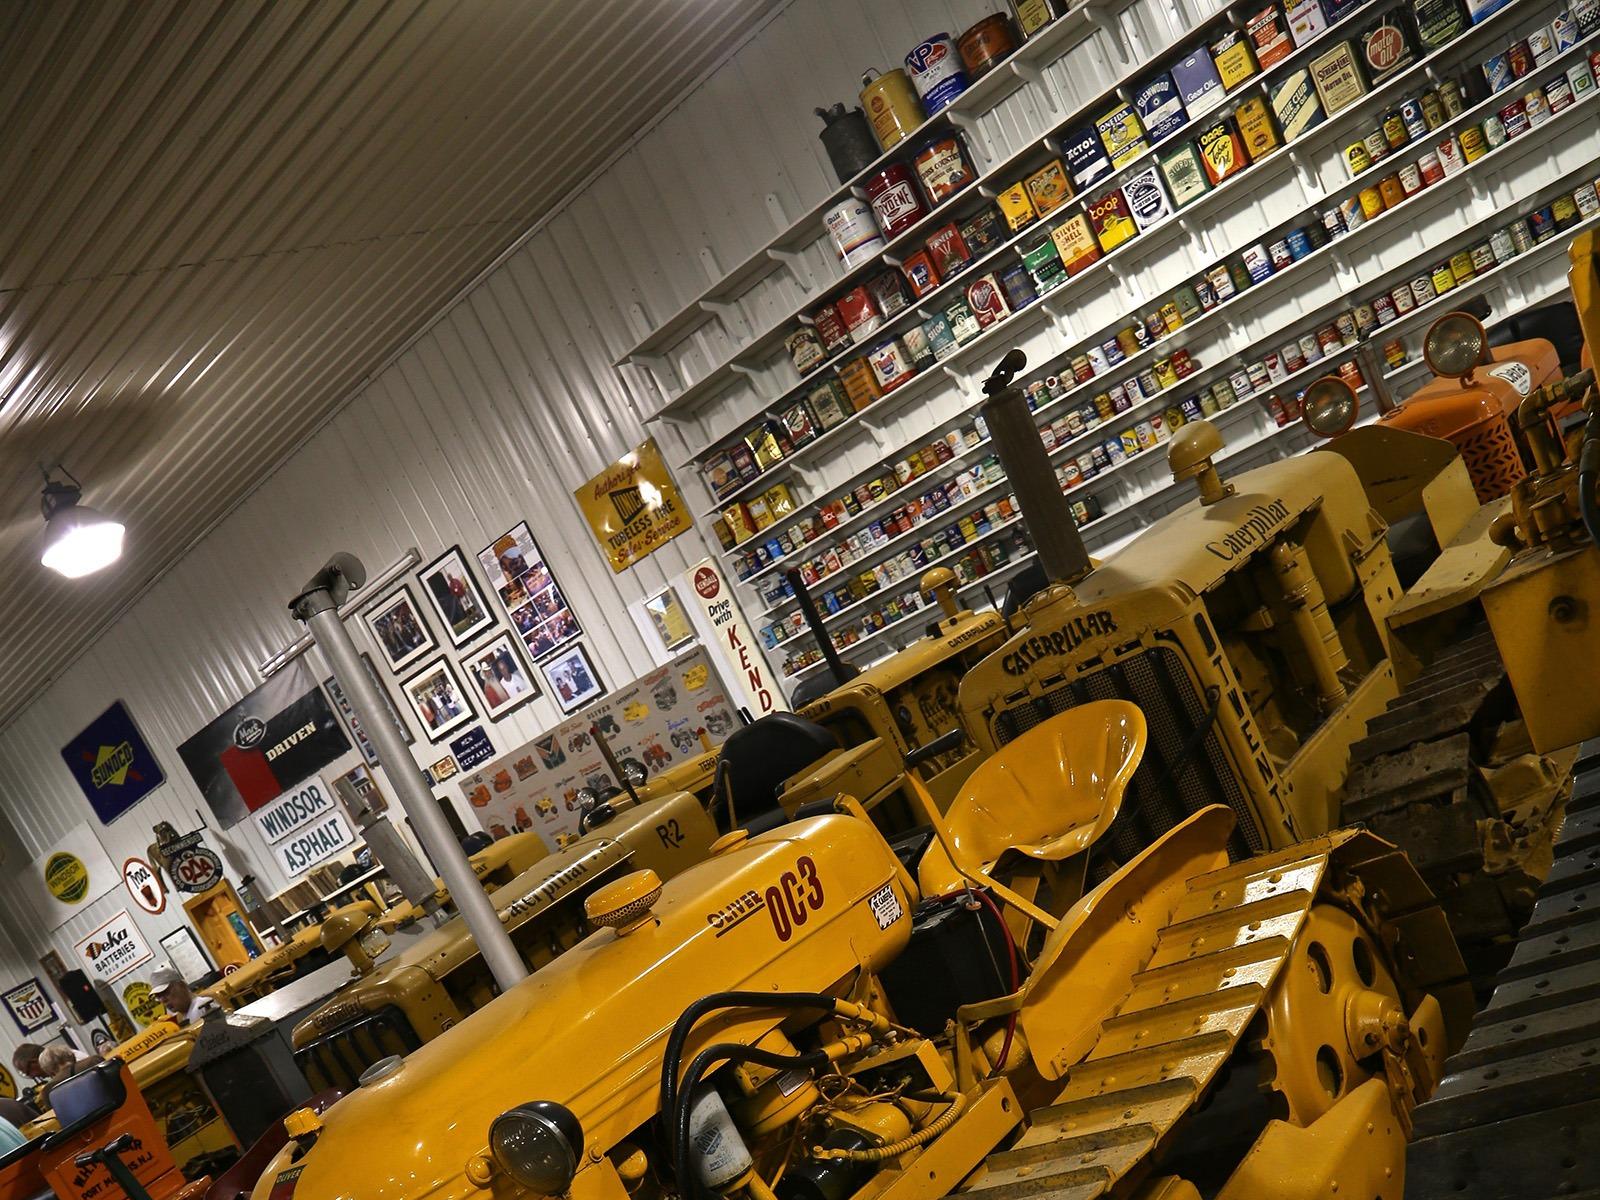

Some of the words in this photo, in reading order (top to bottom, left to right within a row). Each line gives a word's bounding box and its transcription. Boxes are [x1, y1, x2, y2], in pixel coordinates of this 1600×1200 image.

[1136, 82, 1168, 106] GLENWOOD
[1291, 82, 1308, 104] CLUB
[1098, 109, 1128, 131] ONEIDA
[1090, 196, 1120, 220] CO-OP
[1054, 219, 1080, 239] SILVER
[594, 461, 641, 500] Authorized
[607, 517, 652, 550] TUBELESS
[652, 501, 675, 522] TIRE
[1206, 497, 1293, 562] Caterpillar
[708, 599, 730, 618] Drive
[713, 609, 733, 626] with
[947, 619, 996, 648] CATERPILLAR
[1002, 610, 1119, 677] CATERPILLAR
[728, 624, 776, 715] KEND
[265, 721, 317, 762] DRIVEN
[612, 745, 632, 758] LIVER
[94, 744, 132, 786] SUNOCO
[260, 785, 327, 838] WINDSOR
[284, 818, 344, 871] ASPHALT
[51, 863, 81, 889] WINDSOR
[707, 890, 764, 929] OLIVER
[765, 855, 825, 942] OC-3
[87, 928, 129, 961] Deka
[95, 941, 136, 973] BATTERIES
[277, 1167, 303, 1184] OLIVER
